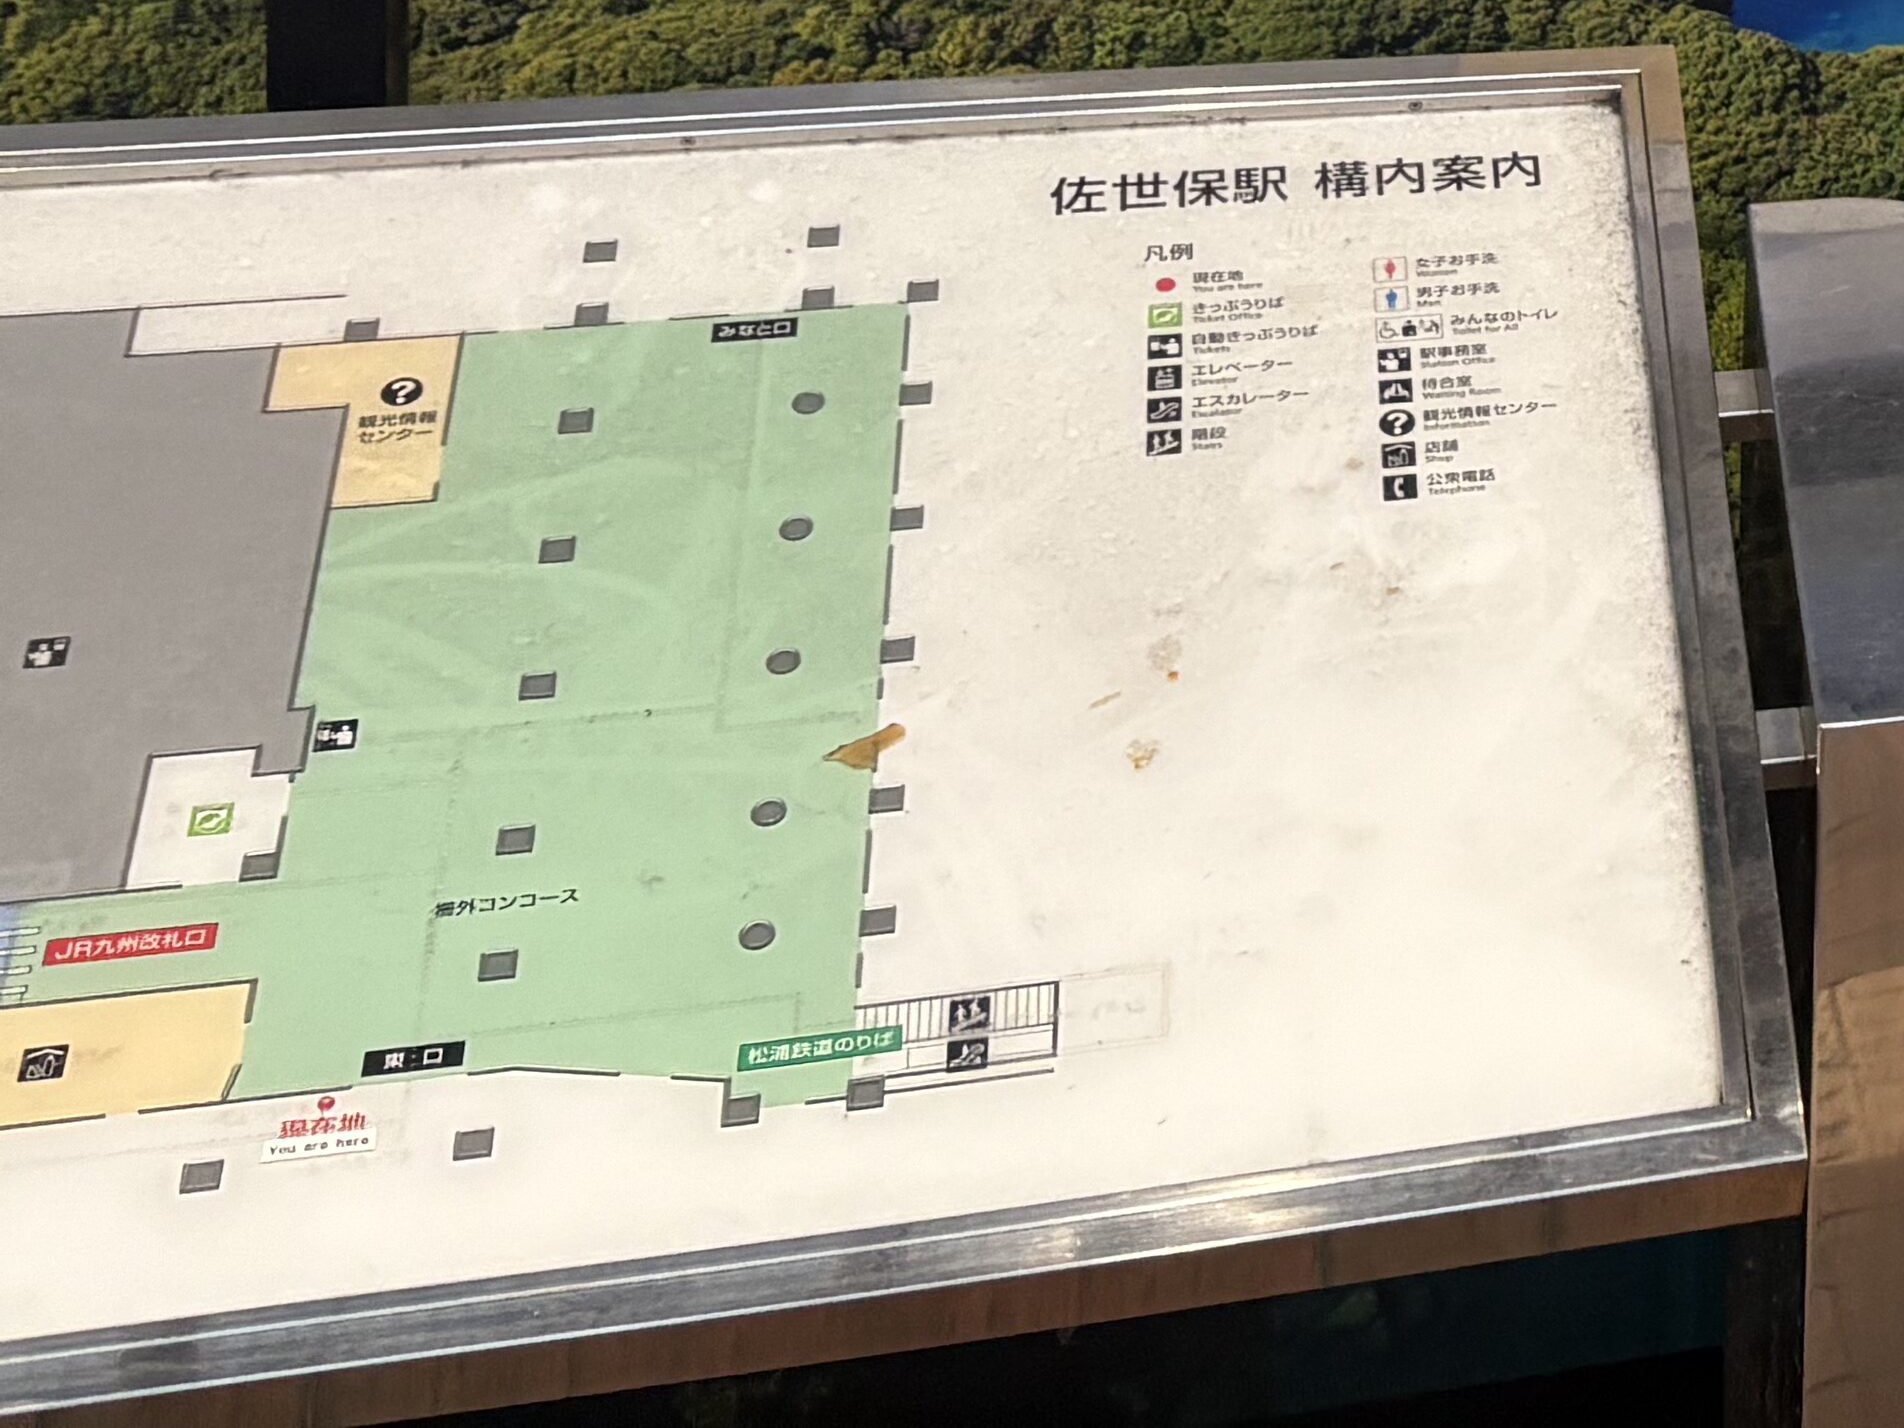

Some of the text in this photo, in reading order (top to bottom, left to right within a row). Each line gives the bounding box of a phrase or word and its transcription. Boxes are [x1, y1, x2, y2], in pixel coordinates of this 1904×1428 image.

[1049, 150, 1543, 215] 佐世保駅 構内案内
[1143, 242, 1194, 263] 凡例
[1191, 359, 1294, 377] エレベーター
[1191, 388, 1310, 409] エスカレーター
[53, 929, 208, 962] JR九州改札口
[747, 1028, 895, 1065] 松浦鉄道のりば
